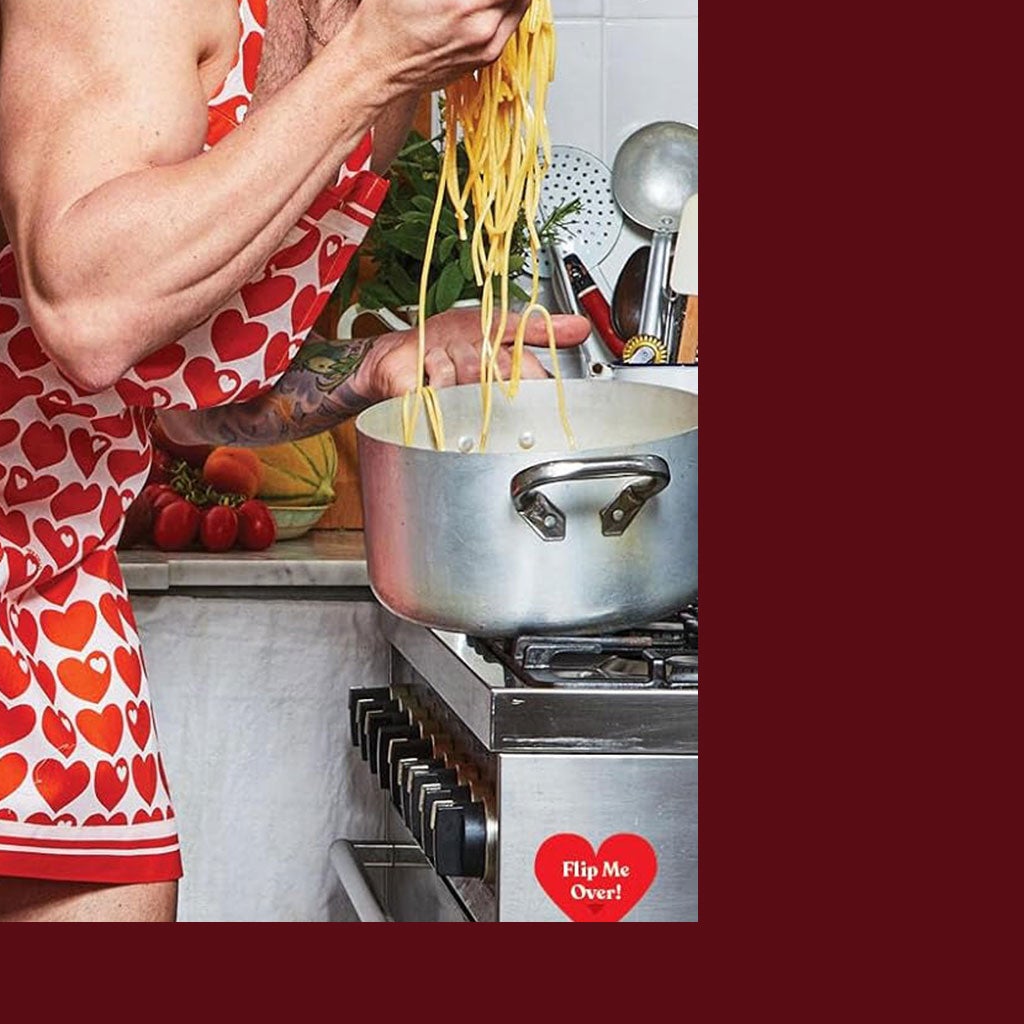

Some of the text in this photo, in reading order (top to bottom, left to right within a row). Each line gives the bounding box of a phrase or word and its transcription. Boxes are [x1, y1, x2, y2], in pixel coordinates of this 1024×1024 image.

[562, 860, 630, 881] Flip Me
[570, 883, 622, 900] Over!
